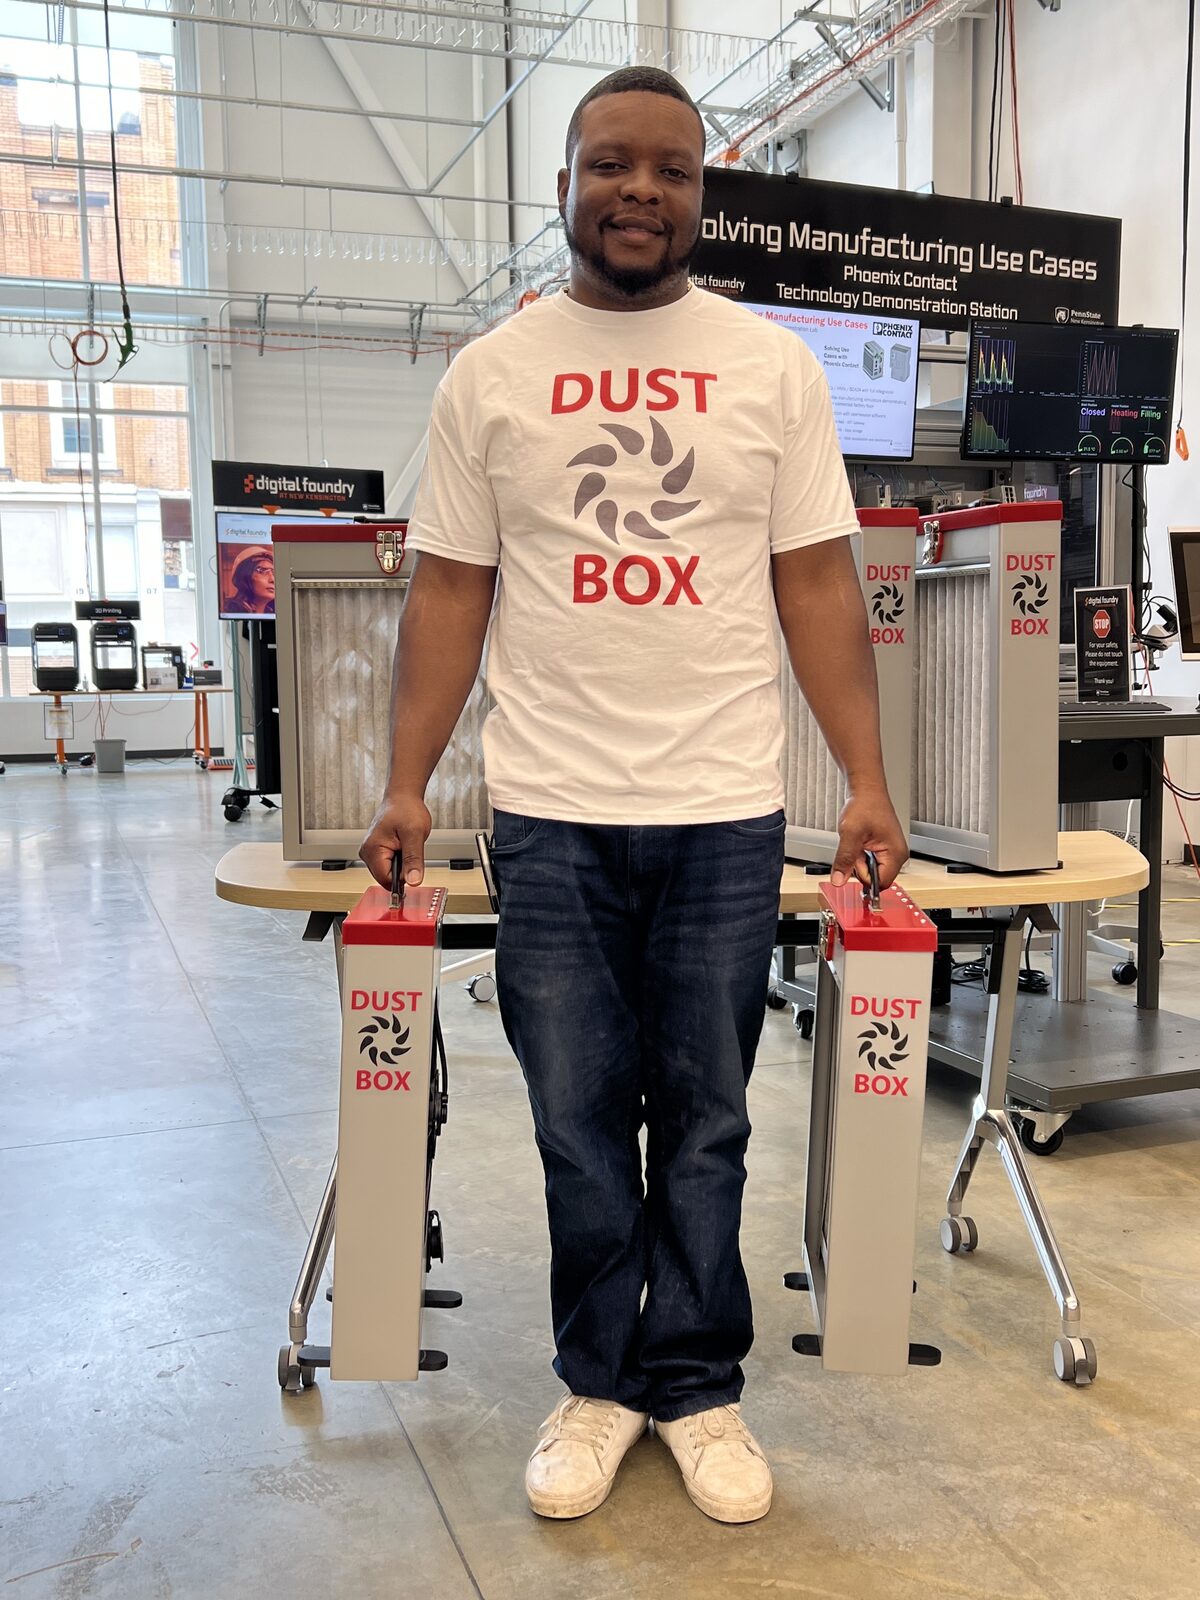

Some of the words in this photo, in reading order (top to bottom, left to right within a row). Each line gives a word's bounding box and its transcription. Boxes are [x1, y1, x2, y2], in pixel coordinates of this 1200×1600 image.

[702, 211, 782, 253] olving
[789, 222, 973, 273] Manufacturing
[979, 243, 1024, 272] Use
[1029, 249, 1098, 281] Cases
[688, 274, 707, 286] ital
[708, 275, 745, 292] foundry
[843, 265, 901, 286] Phoenix
[903, 272, 958, 292] Contact
[776, 283, 860, 309] Technology
[863, 291, 966, 316] Demonstration
[969, 301, 1018, 321] Station
[765, 311, 825, 327] Manufacturing
[827, 318, 842, 327] Use
[844, 320, 868, 330] Cases
[882, 330, 913, 338] CONTACT
[551, 368, 718, 415] DUST
[1080, 408, 1106, 416] Closed
[1111, 409, 1138, 419] Heating
[1140, 410, 1161, 420] Filling
[256, 475, 300, 494] digital
[302, 477, 355, 498] foundry
[1024, 486, 1047, 499] foundry
[1006, 554, 1056, 571] DUST
[573, 554, 704, 606] BOX
[867, 565, 911, 582] DUST
[1011, 618, 1049, 636] BOX
[1094, 618, 1110, 630] STOP
[871, 628, 905, 644] BOX
[351, 990, 423, 1012] DUST
[851, 996, 922, 1019] DUST
[356, 1070, 411, 1091] BOX
[854, 1073, 909, 1097] BOX
